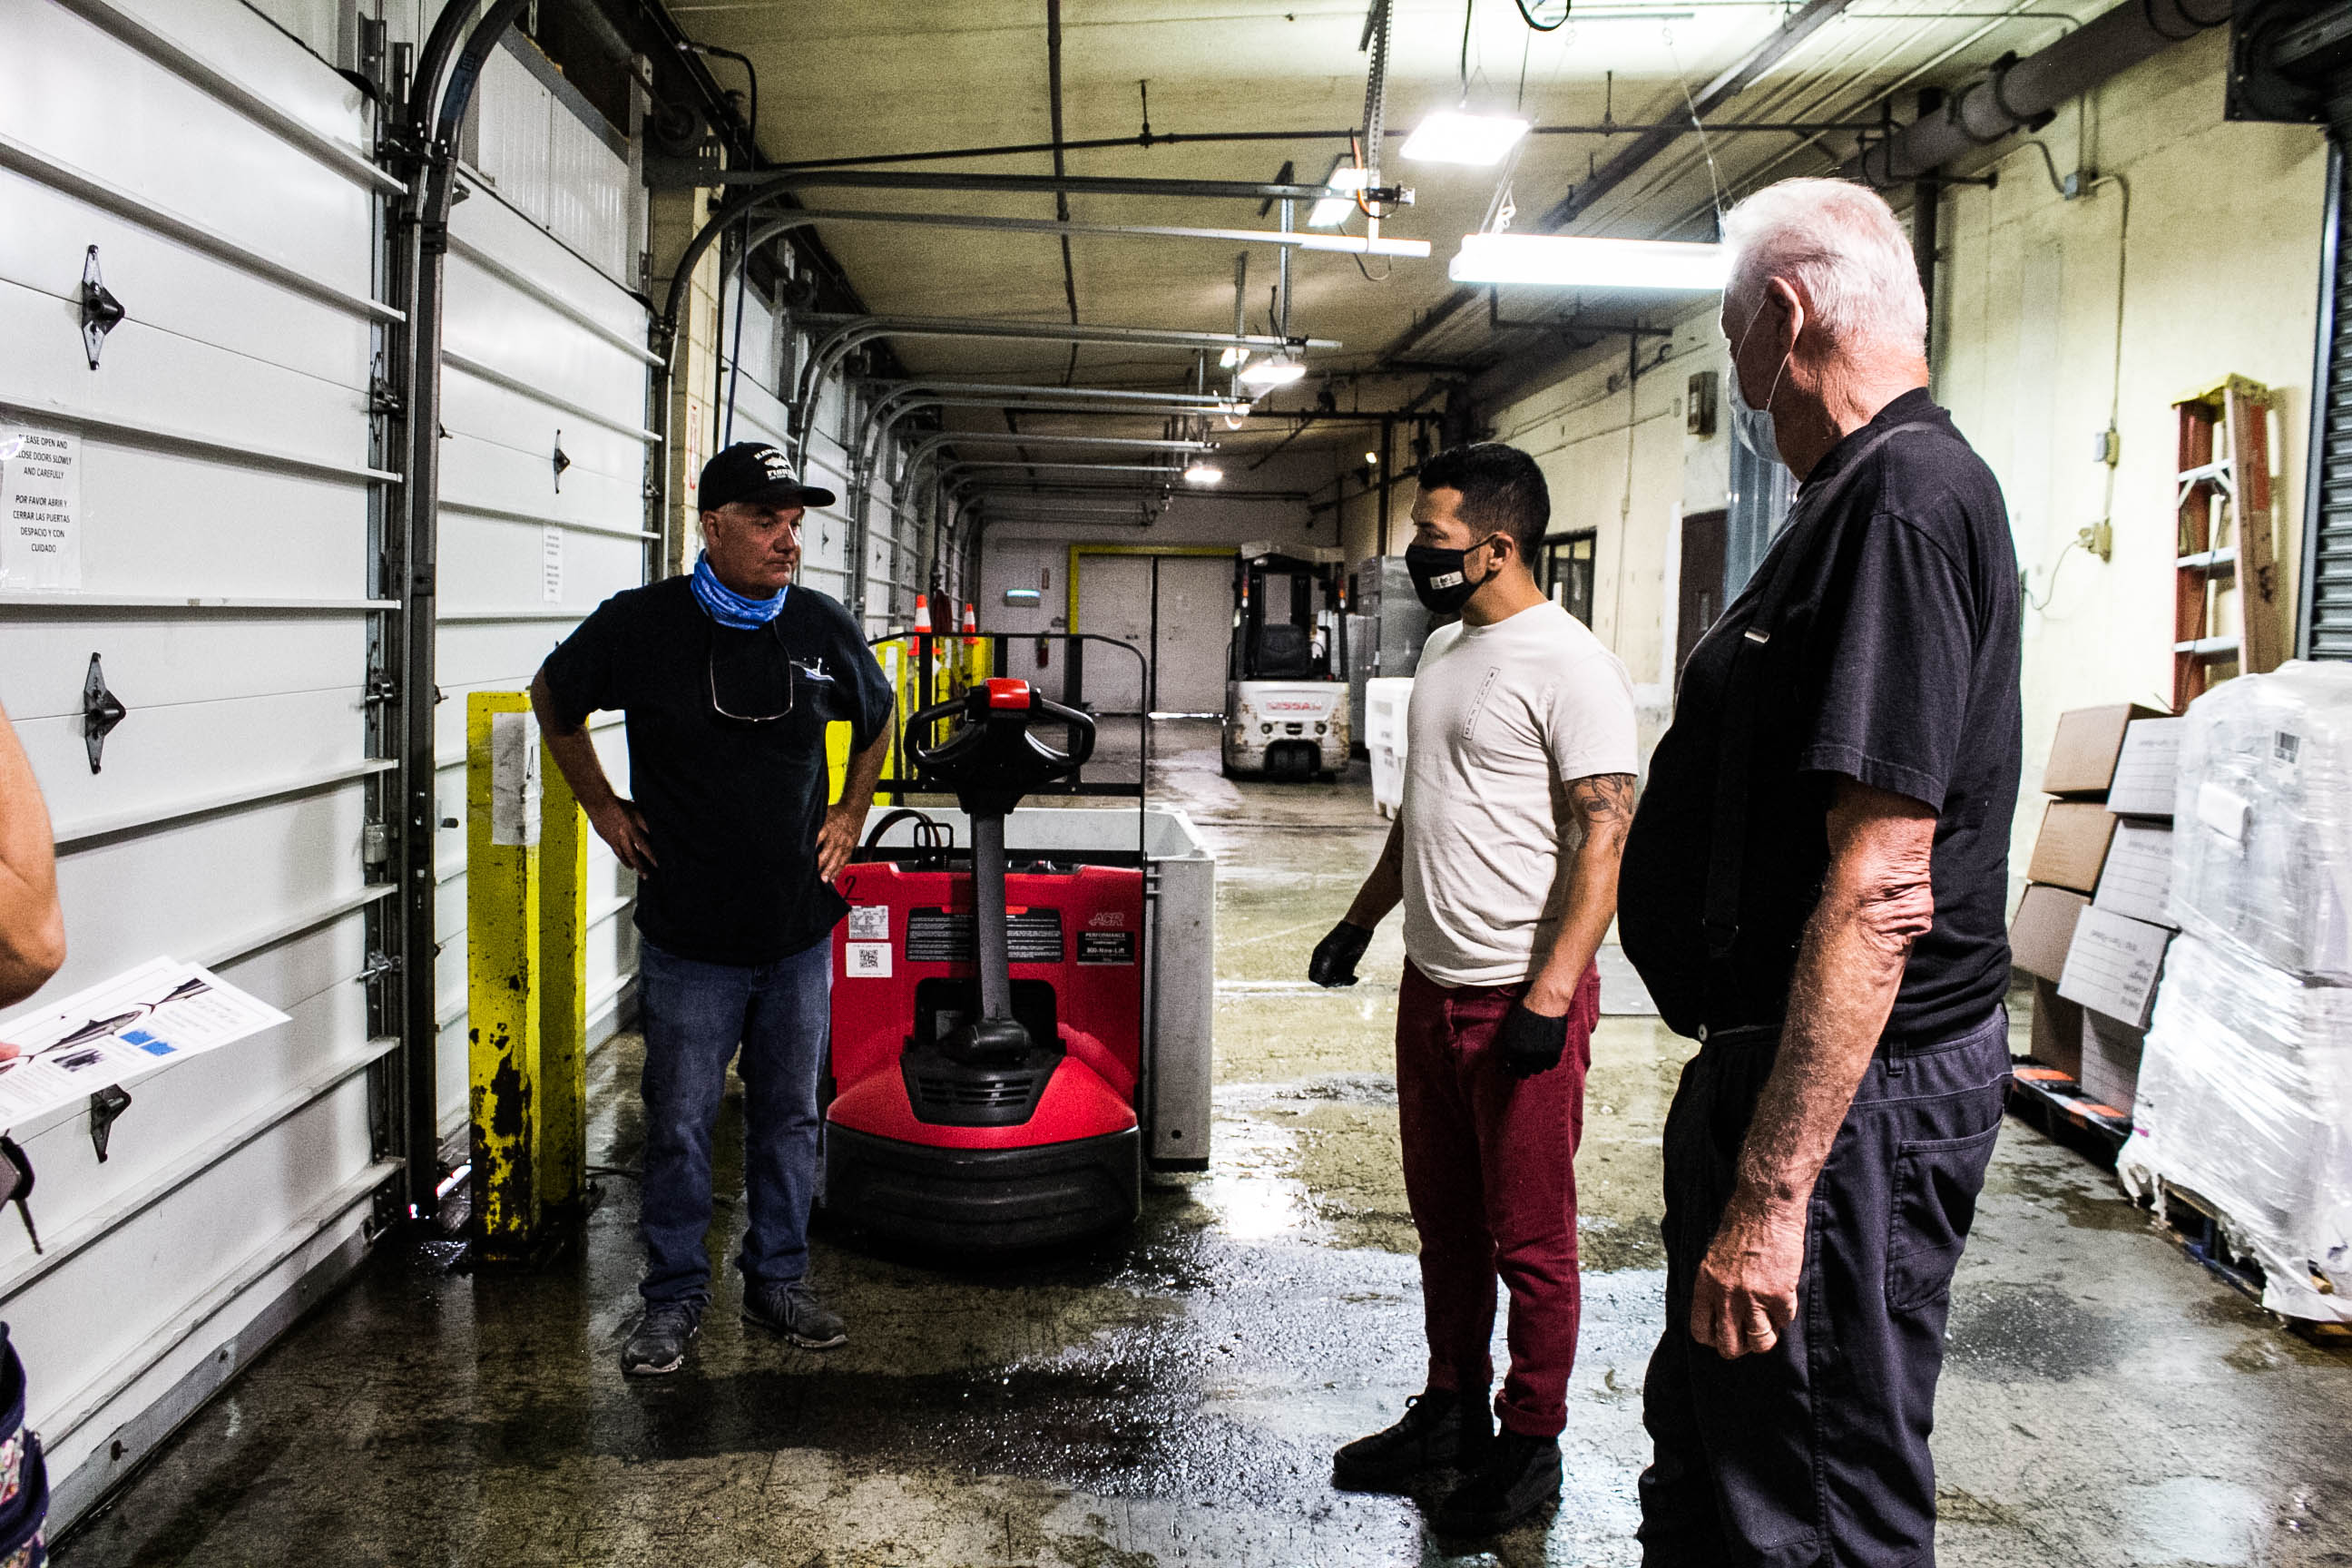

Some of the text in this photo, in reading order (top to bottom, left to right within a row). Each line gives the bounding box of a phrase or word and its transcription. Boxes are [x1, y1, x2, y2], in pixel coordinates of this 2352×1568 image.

[41, 437, 55, 447] OPEN
[56, 440, 68, 449] AND
[33, 451, 52, 463] DOORS
[53, 455, 72, 466] SLOWLY
[24, 466, 64, 479] AND CAREFULLY
[15, 495, 67, 508] POR FAVOR ABRIR Y
[13, 510, 71, 524] CERRAR LAS PUERTAS
[20, 526, 65, 538] DESPACIO Y CON
[31, 543, 57, 553] CUIDADO
[845, 875, 865, 900] 2
